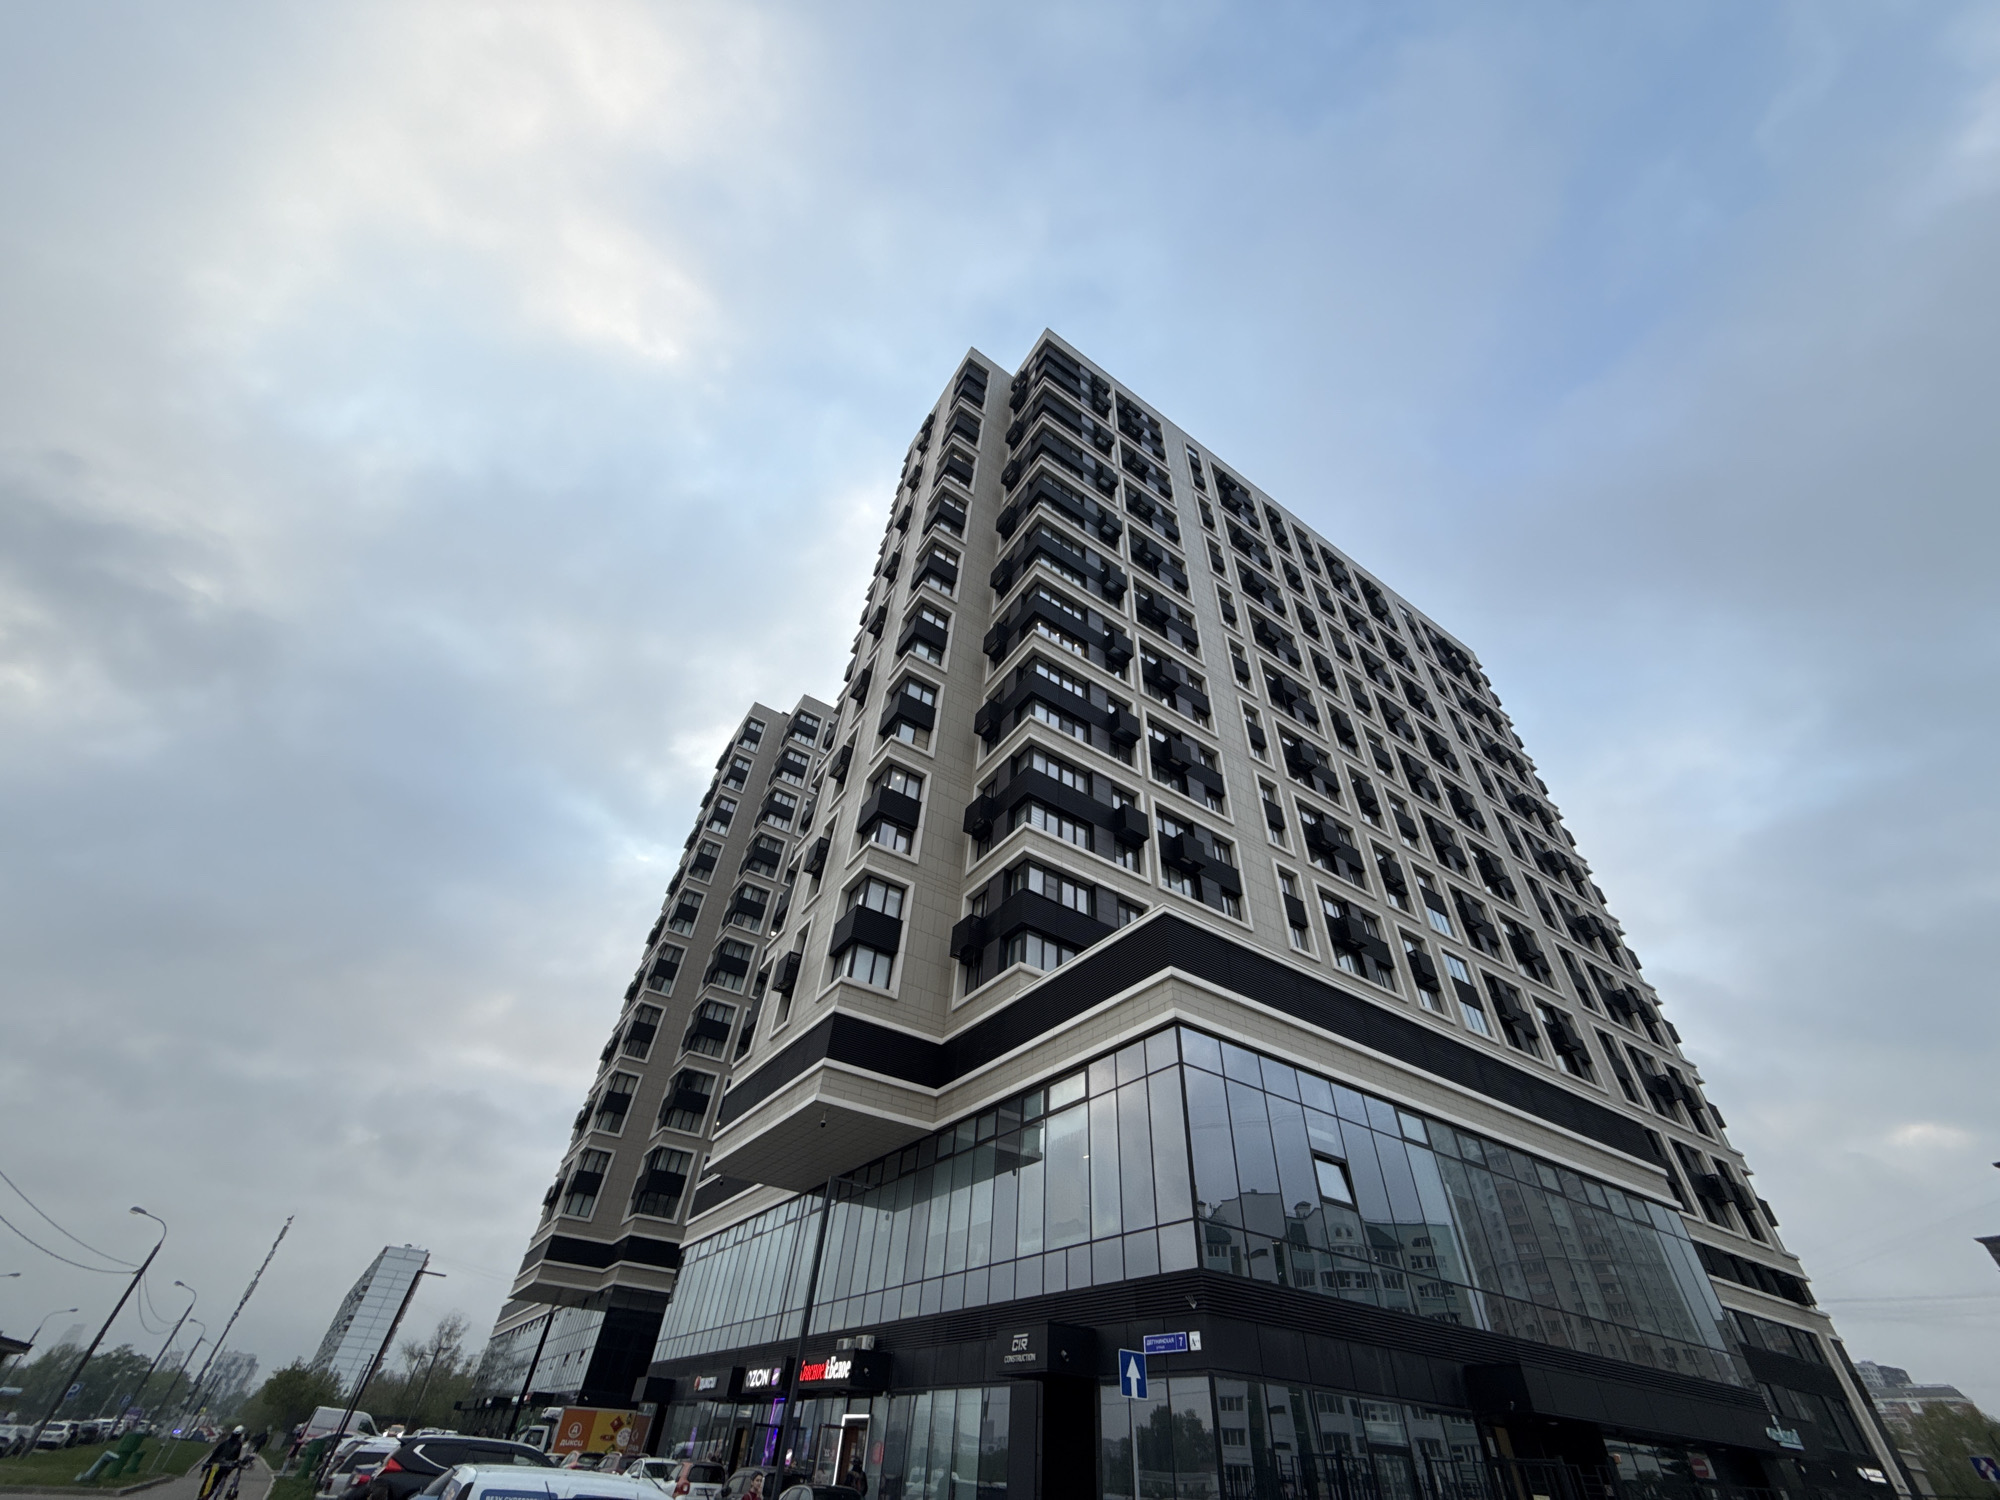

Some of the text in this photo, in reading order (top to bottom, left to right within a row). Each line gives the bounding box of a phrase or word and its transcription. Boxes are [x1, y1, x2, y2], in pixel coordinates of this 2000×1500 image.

[1178, 1337, 1183, 1347] 7
[1004, 1353, 1036, 1363] CONSTRUCTION
[746, 1369, 771, 1387] OZON
